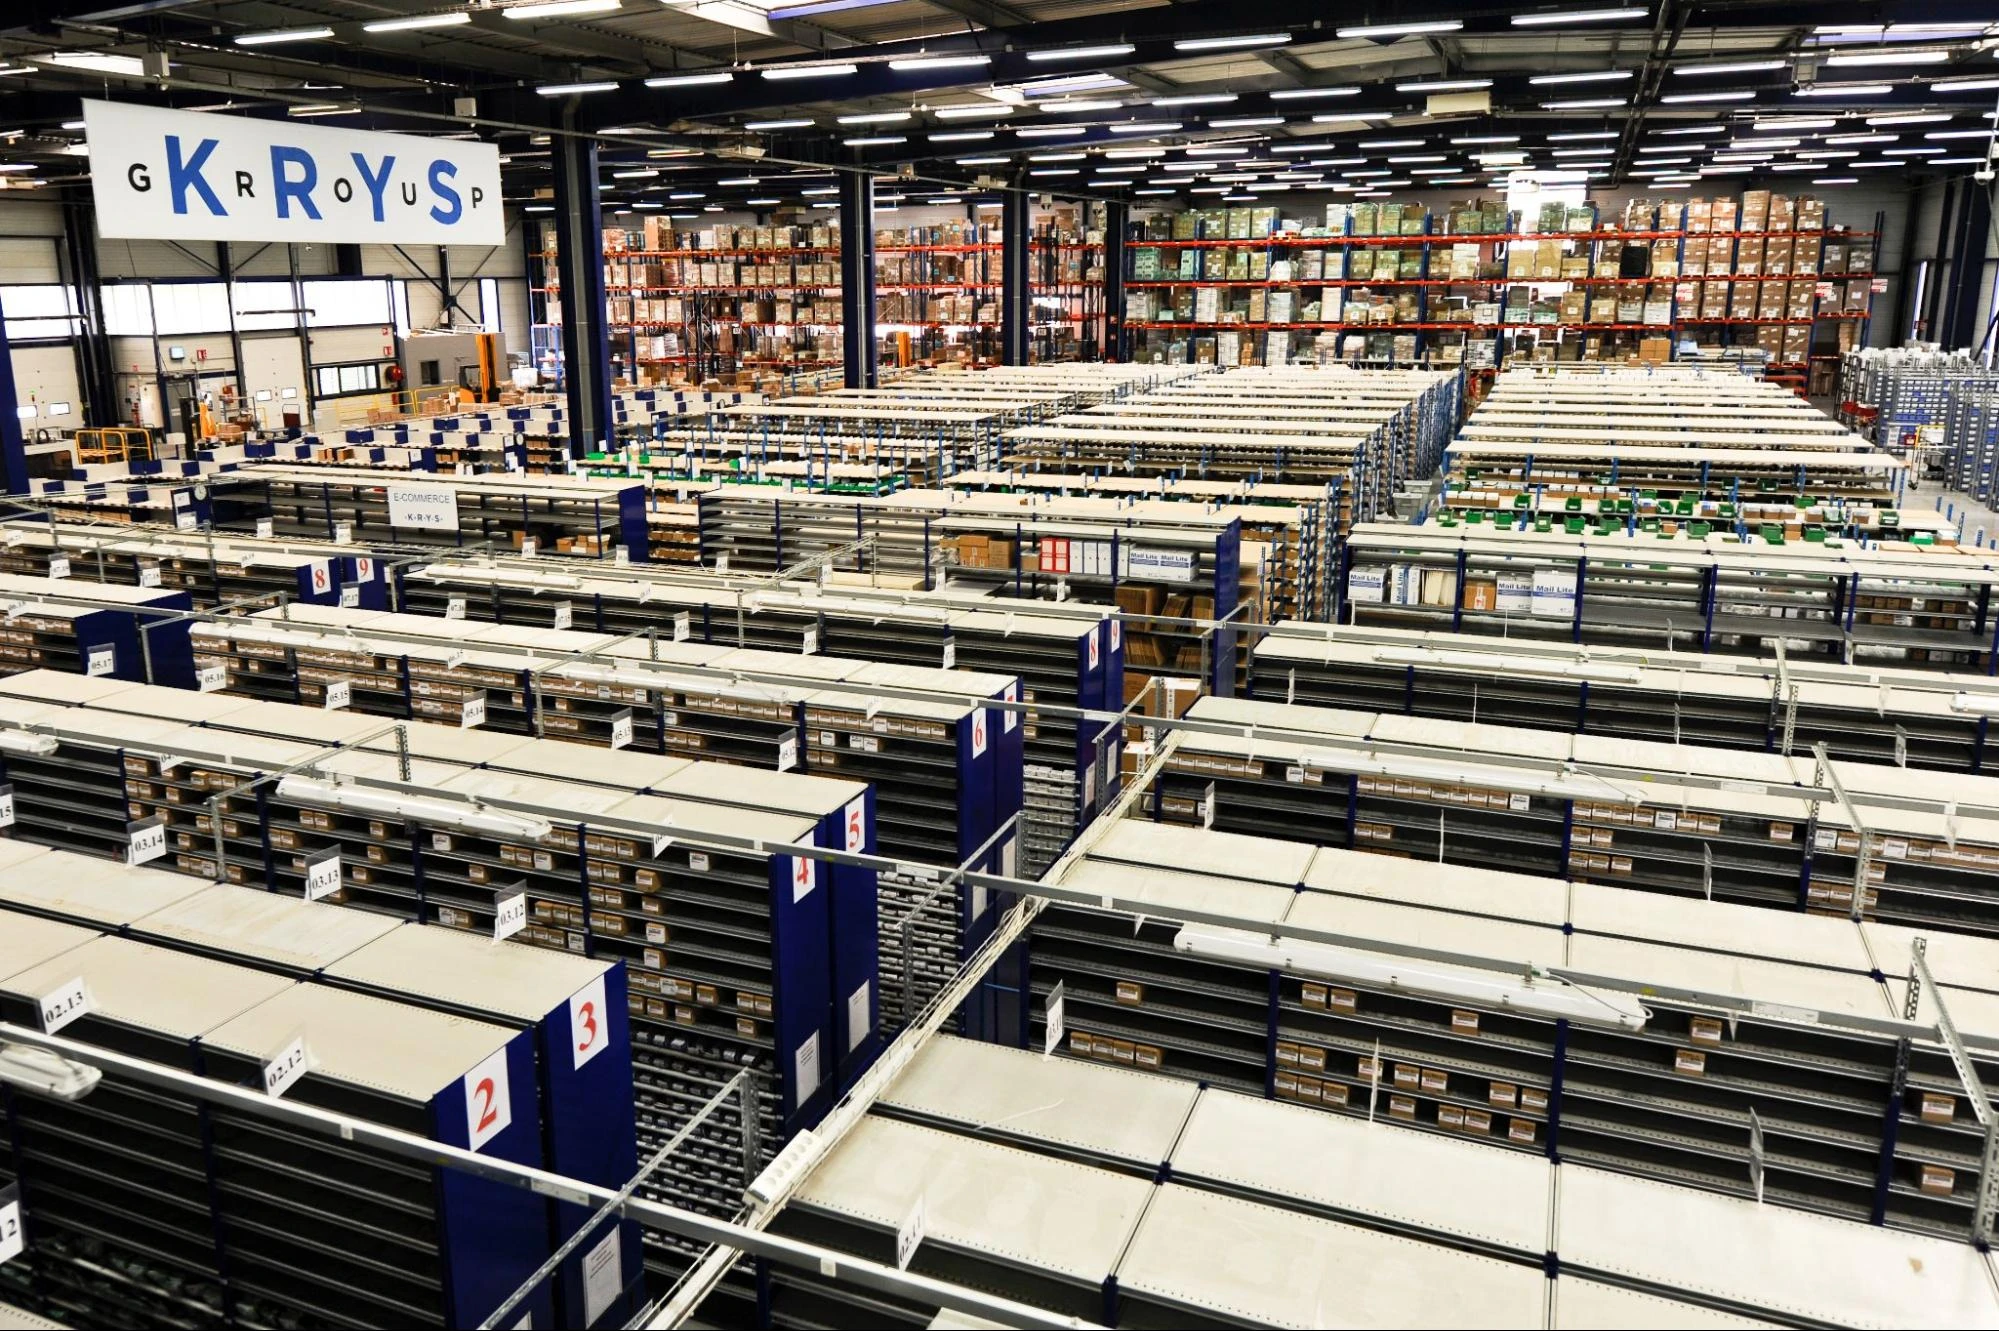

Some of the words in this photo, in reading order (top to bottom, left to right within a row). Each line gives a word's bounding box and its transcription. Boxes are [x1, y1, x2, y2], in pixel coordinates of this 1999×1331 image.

[393, 492, 451, 504] E-COMMERCE
[359, 558, 369, 578] 9
[1350, 574, 1366, 582] Mail
[314, 568, 326, 589] 8
[1536, 584, 1553, 592] Mail
[1555, 585, 1574, 593] Lite
[1090, 637, 1096, 662] 8
[91, 658, 112, 670] 05.17
[204, 673, 225, 684] 05.16
[329, 690, 349, 703] 05.15
[465, 706, 483, 719] 05.14
[975, 717, 983, 748] 6
[848, 811, 860, 848] 5
[134, 833, 163, 852] 03.14
[312, 870, 339, 889] 03.13
[797, 855, 809, 885] 4
[500, 903, 524, 926] 03.12
[45, 991, 84, 1025] 02.13
[577, 1001, 597, 1051] 3
[268, 1049, 303, 1088] 02.12
[474, 1077, 497, 1133] 2
